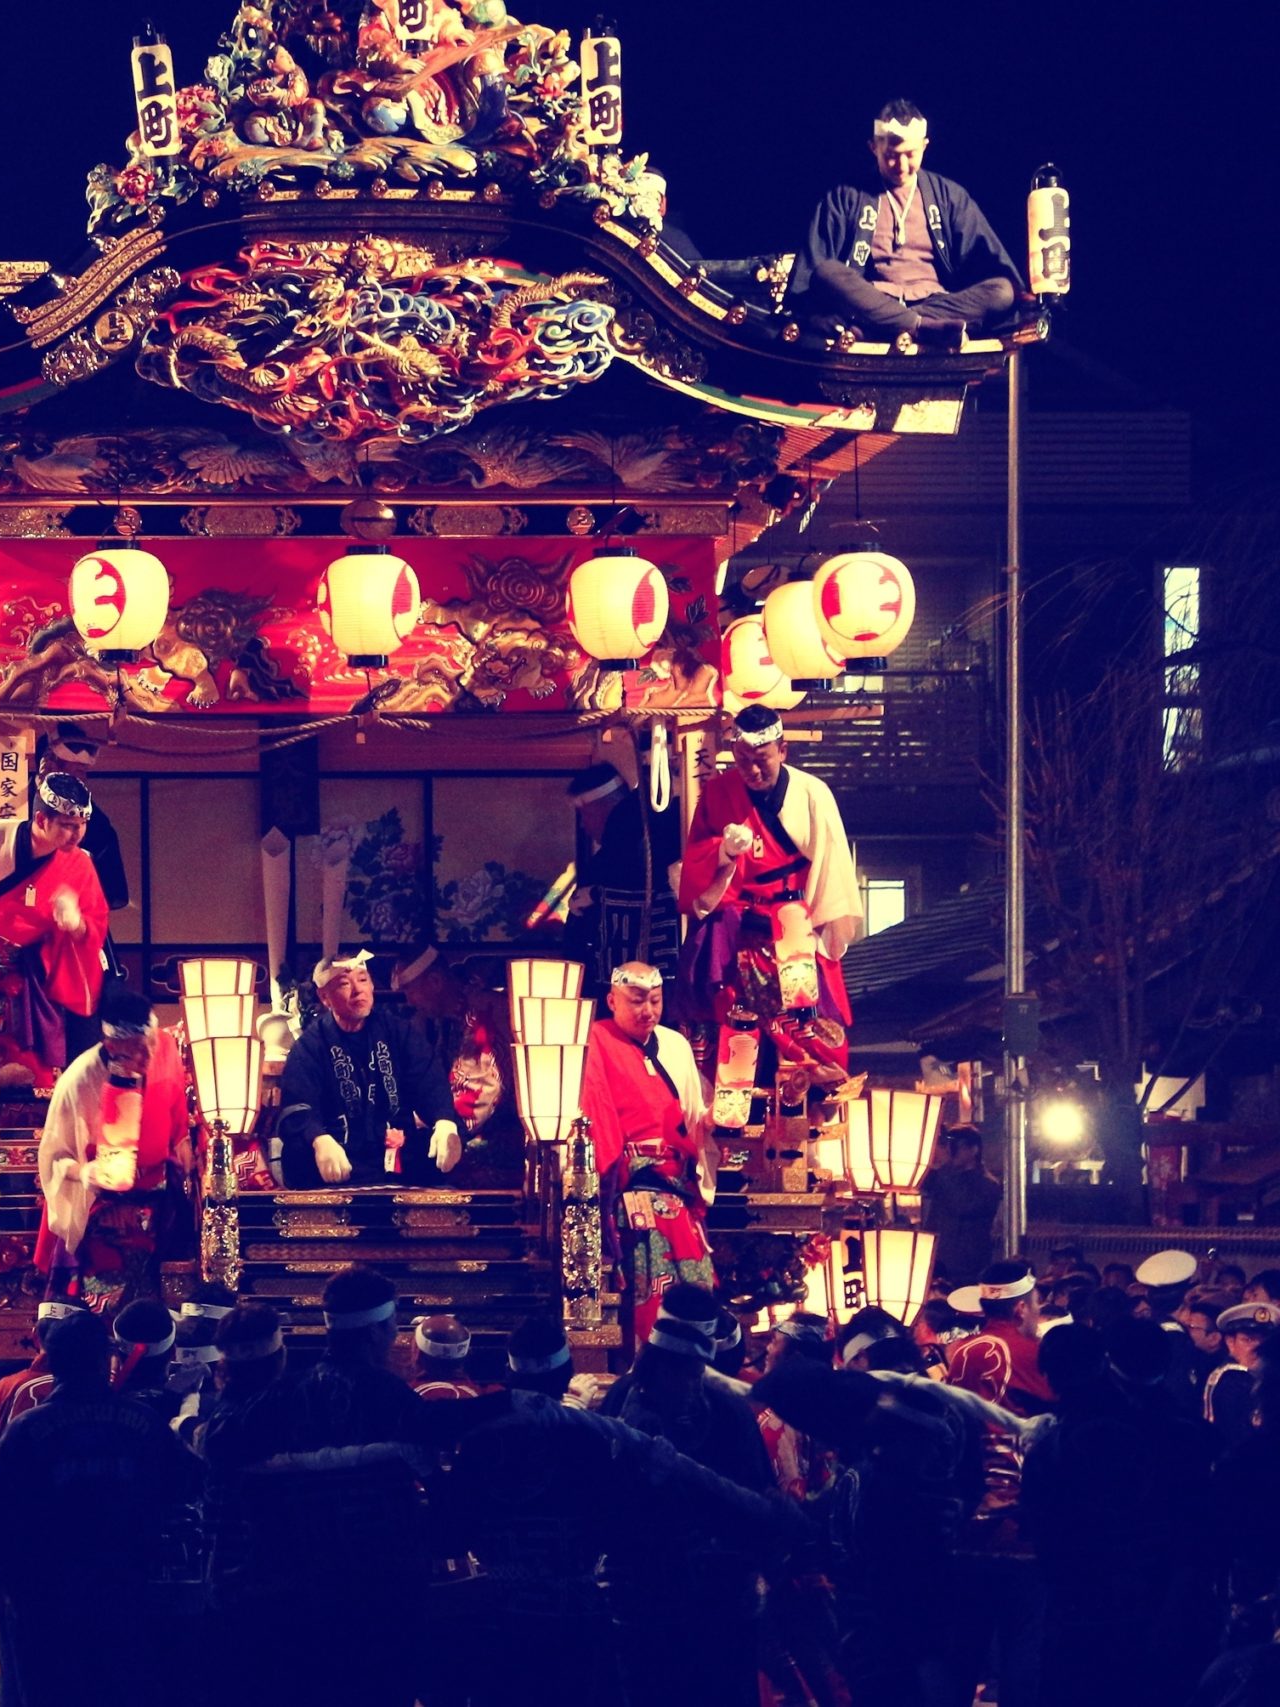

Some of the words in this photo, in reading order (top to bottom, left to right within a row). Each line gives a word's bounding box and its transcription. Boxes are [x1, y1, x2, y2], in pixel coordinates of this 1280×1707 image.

[137, 52, 173, 149] 上町
[586, 41, 621, 137] 上町
[1039, 193, 1070, 287] 上町
